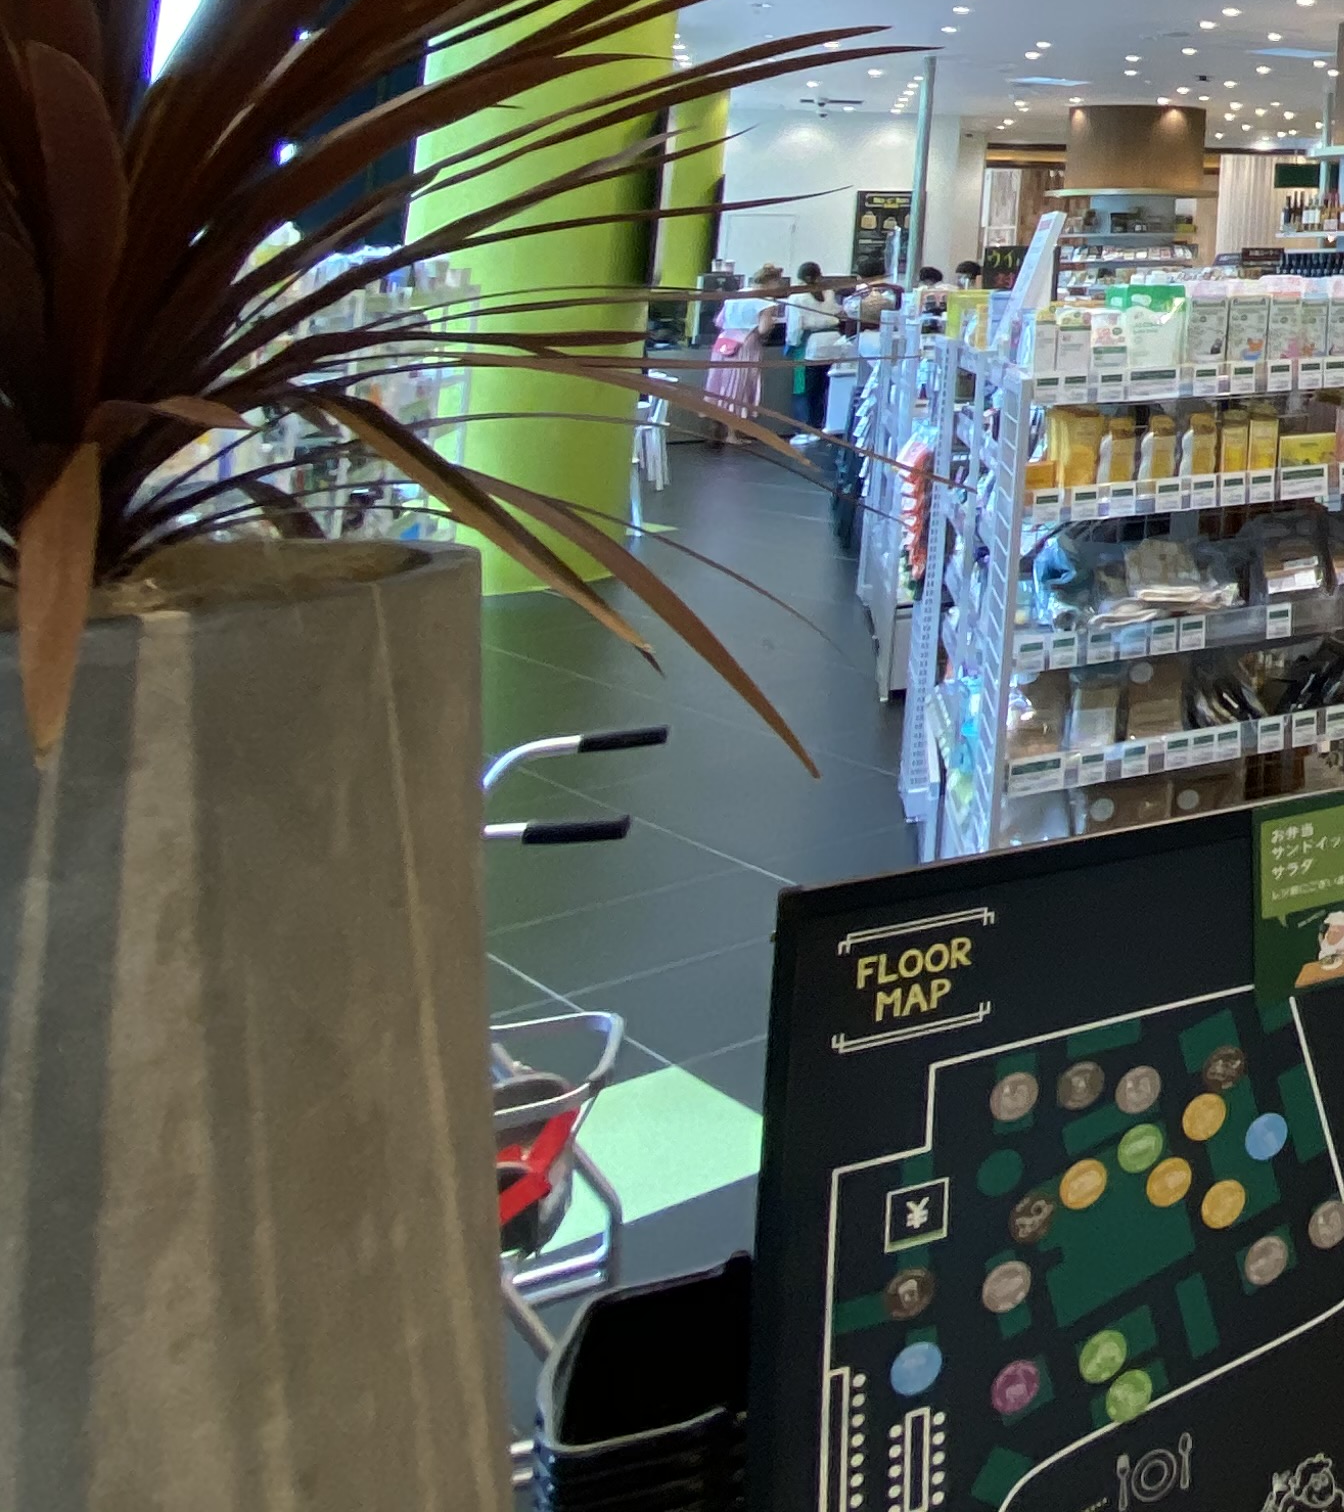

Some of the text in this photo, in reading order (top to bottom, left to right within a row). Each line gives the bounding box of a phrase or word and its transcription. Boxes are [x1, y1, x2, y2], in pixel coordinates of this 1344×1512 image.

[1271, 823, 1314, 844] お弁当
[1271, 858, 1314, 881] サラダ
[855, 936, 973, 990] FLOOR
[875, 978, 952, 1023] MAP
